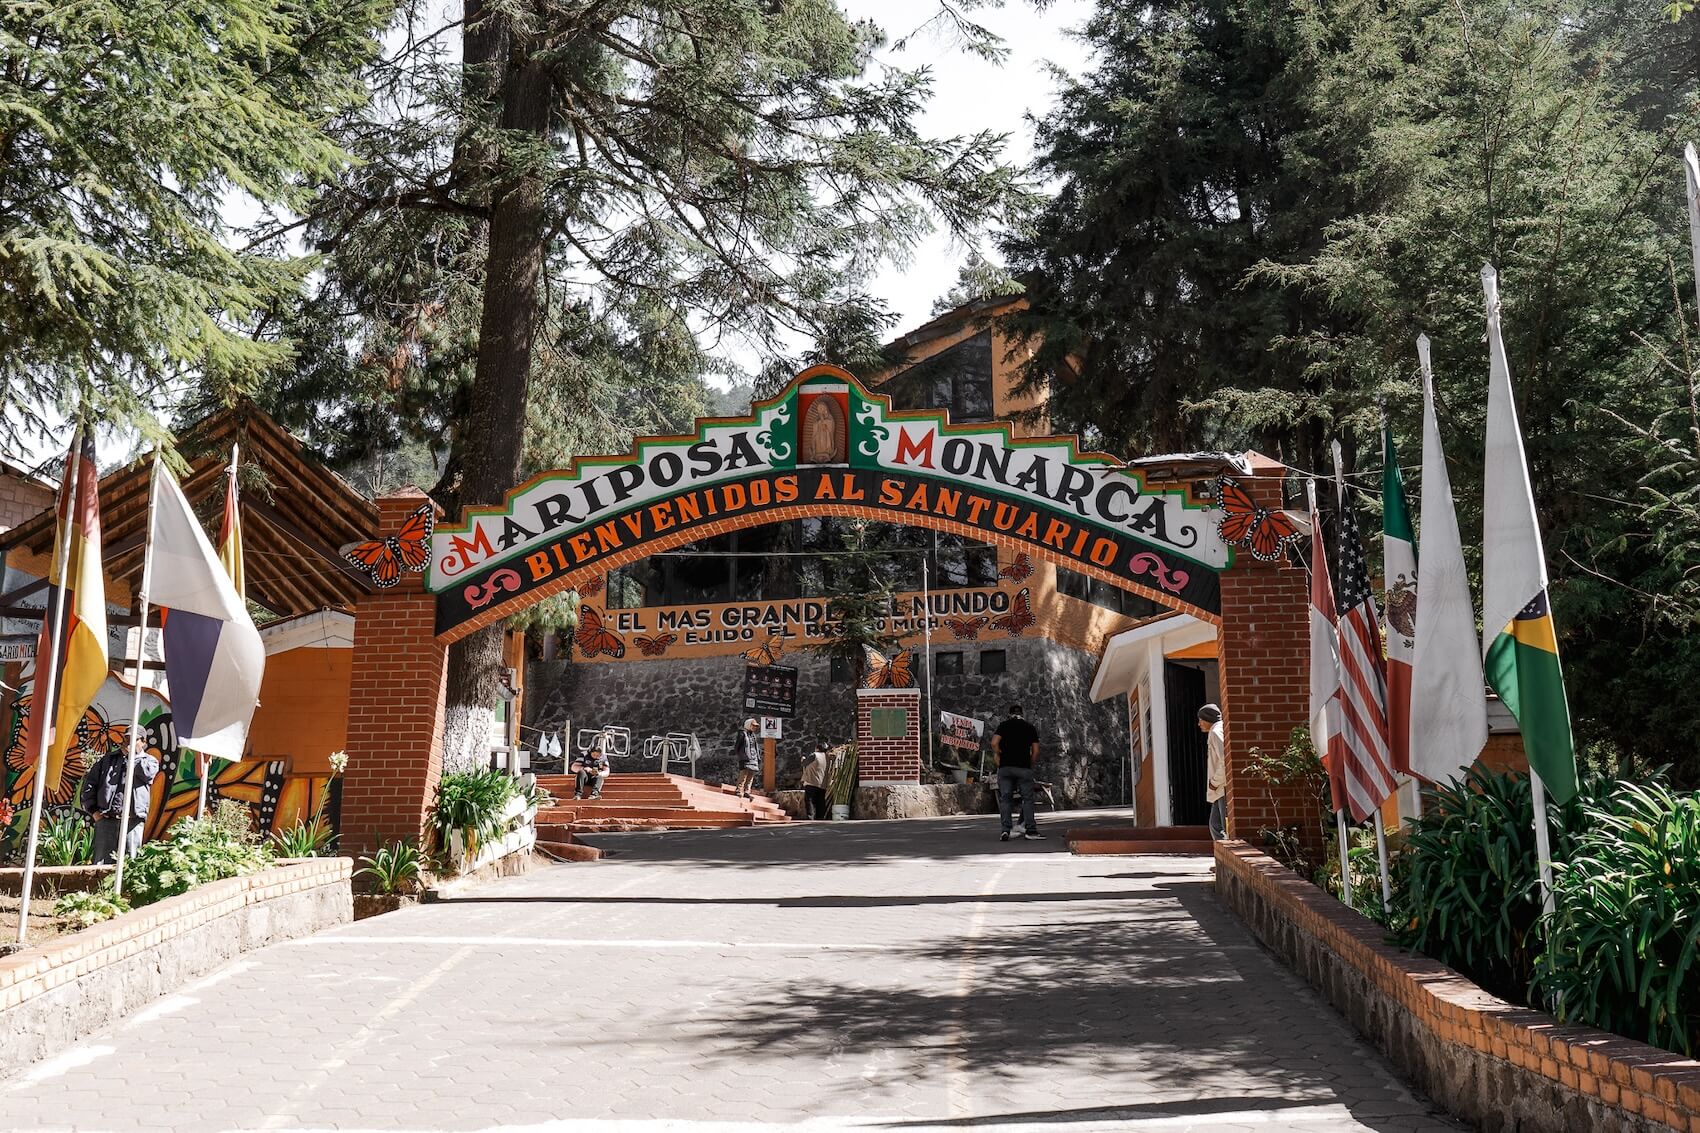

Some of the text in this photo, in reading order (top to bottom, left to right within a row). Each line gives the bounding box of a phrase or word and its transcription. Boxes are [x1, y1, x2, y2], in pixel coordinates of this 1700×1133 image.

[440, 425, 1198, 576] MARIPOSA MONARCA
[525, 473, 1119, 582] BIENVENIDOS AL SANTUARIO
[657, 608, 711, 632] MAS
[911, 590, 1010, 618] MUNDO
[684, 628, 754, 646] EJIDO
[765, 625, 796, 640] EL
